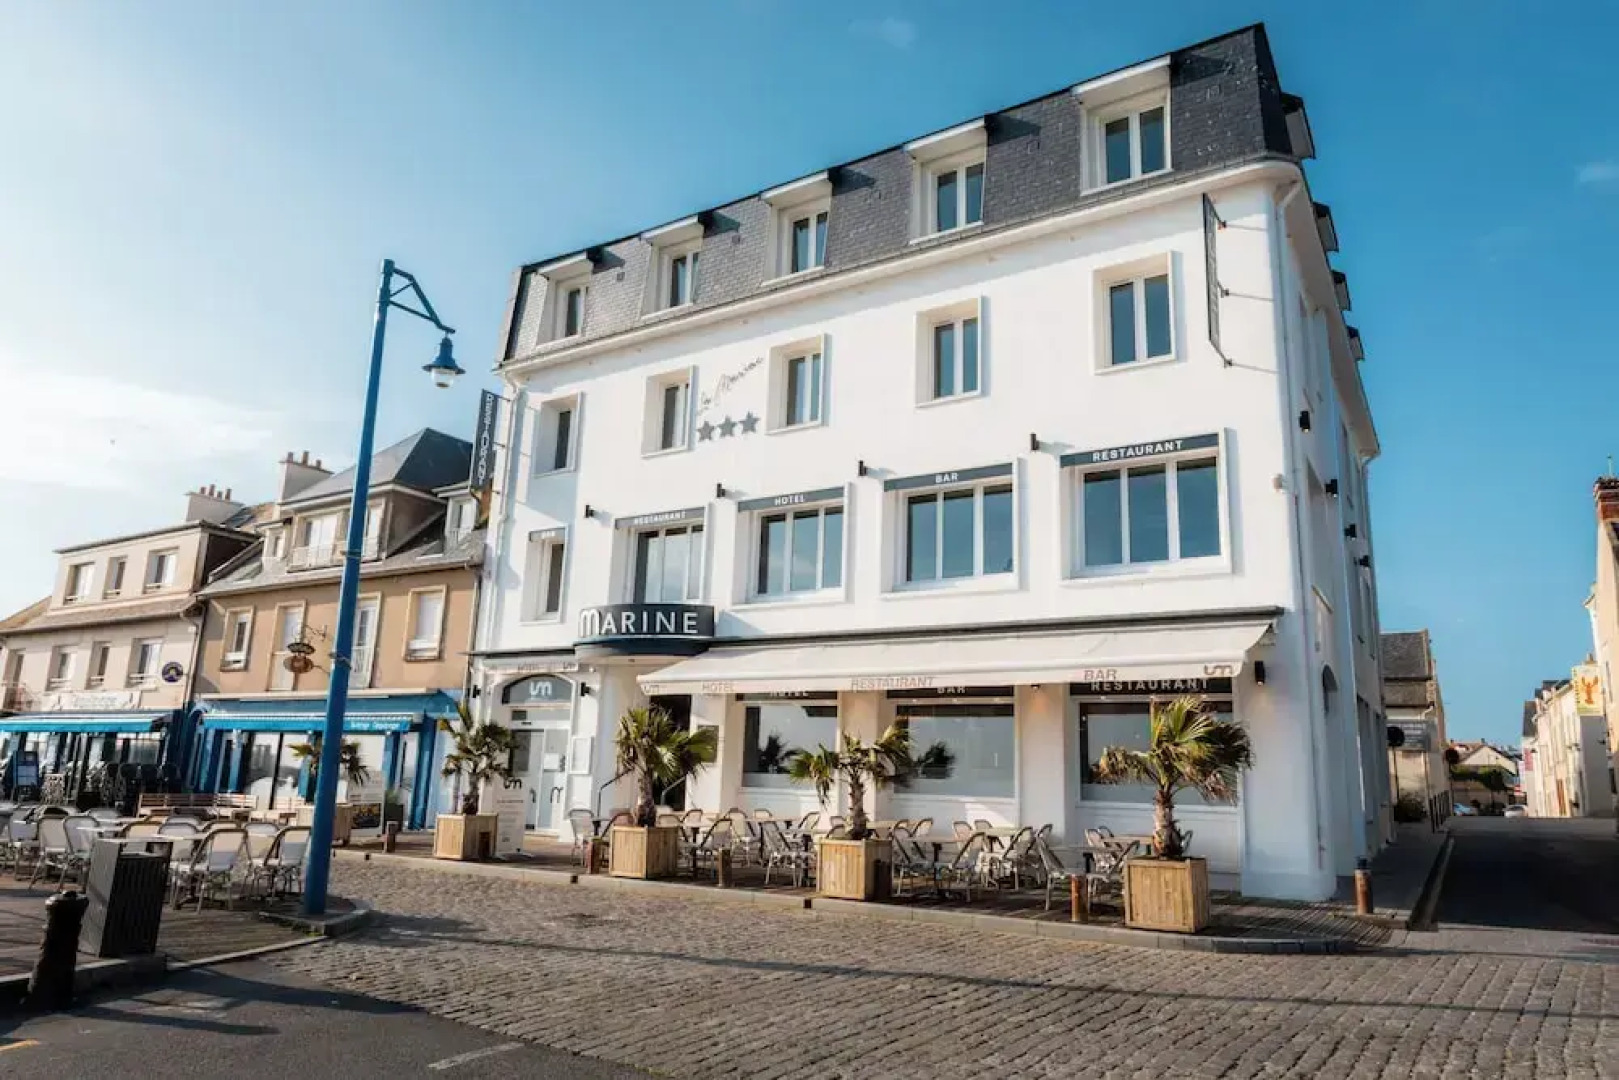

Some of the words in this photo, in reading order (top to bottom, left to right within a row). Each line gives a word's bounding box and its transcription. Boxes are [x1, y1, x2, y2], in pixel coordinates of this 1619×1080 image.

[478, 393, 494, 485] RESTAURANT
[1092, 440, 1183, 462] RESTAURANT
[935, 472, 959, 483] BAR
[775, 494, 805, 506] HOTEL
[634, 511, 687, 525] RESTAURANT
[580, 608, 698, 638] MARINE
[1084, 668, 1117, 681] BAR
[701, 682, 735, 693] HOTEL
[850, 677, 934, 690] RESTAURANT
[1090, 679, 1208, 692] RESTAURANT
